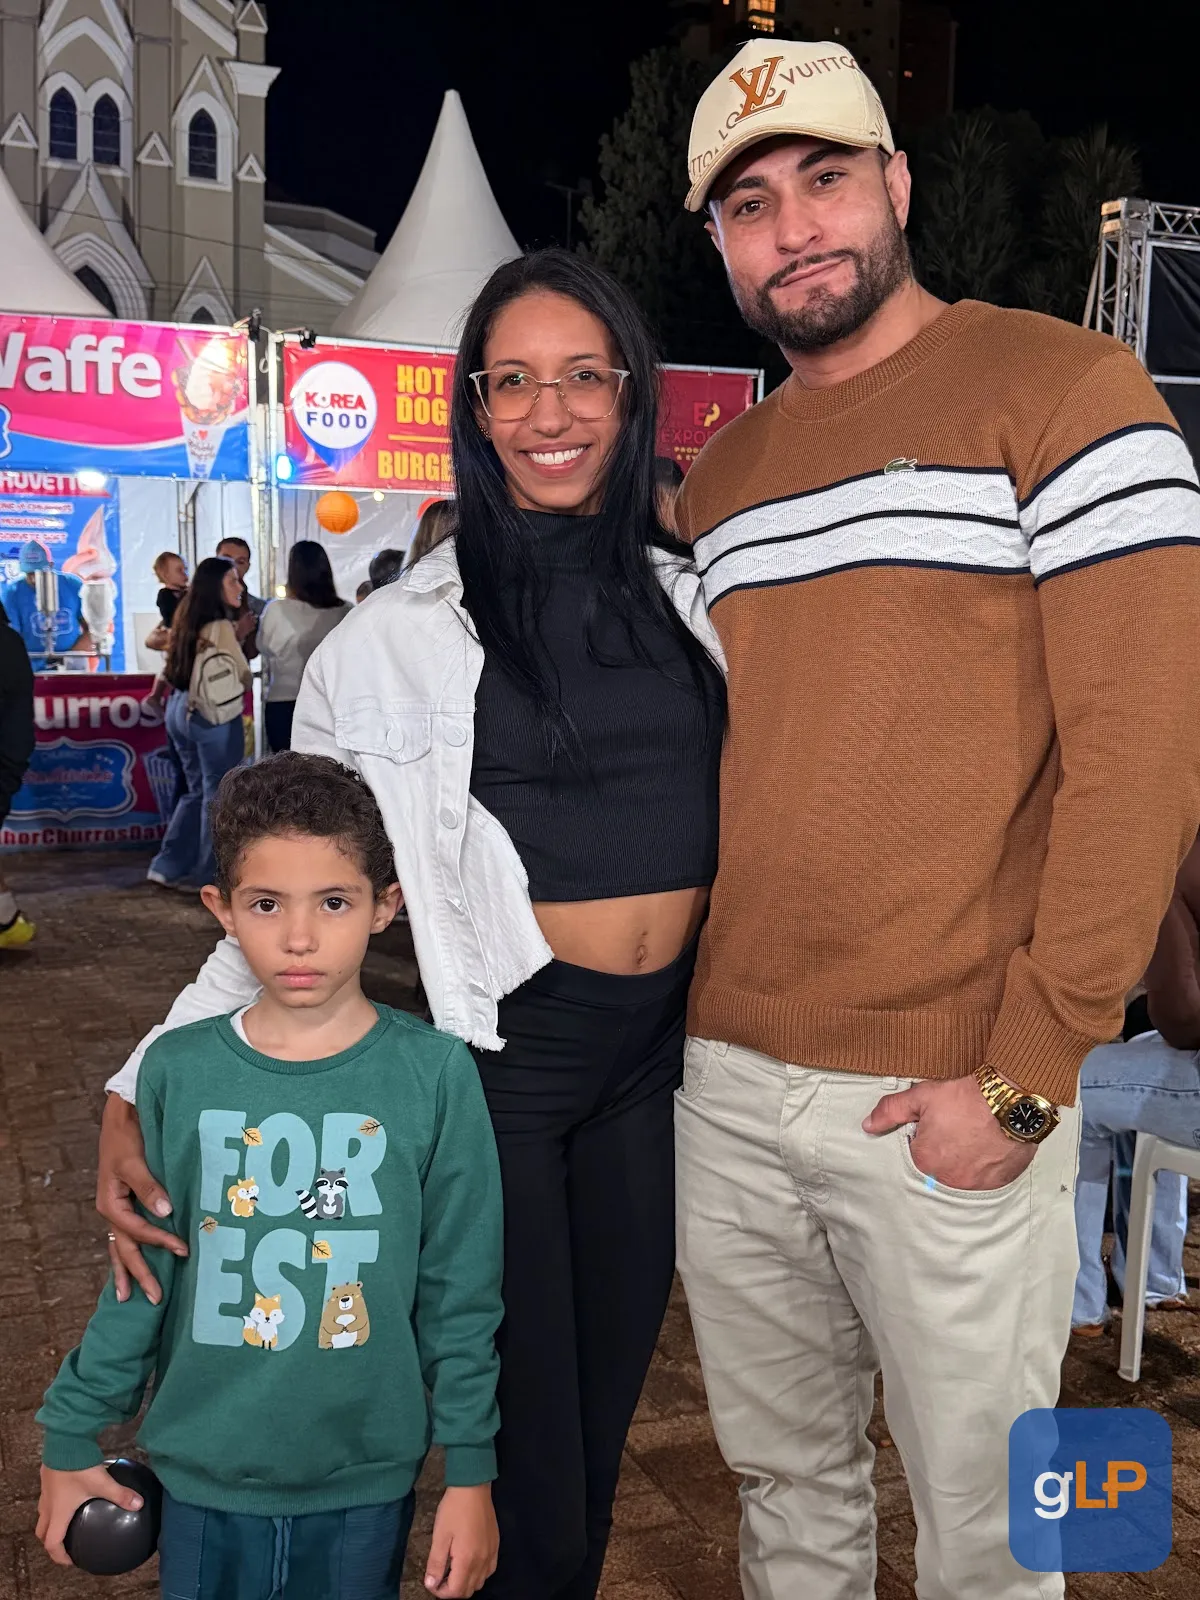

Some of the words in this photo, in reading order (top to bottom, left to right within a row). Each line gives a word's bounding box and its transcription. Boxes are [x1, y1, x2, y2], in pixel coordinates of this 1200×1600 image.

[728, 55, 786, 122] LV
[396, 364, 448, 395] HOT
[305, 391, 367, 411] KOREA
[395, 395, 449, 427] DOG
[306, 411, 367, 429] FOOD
[197, 1109, 387, 1218] FOR
[191, 1222, 380, 1352] EST
